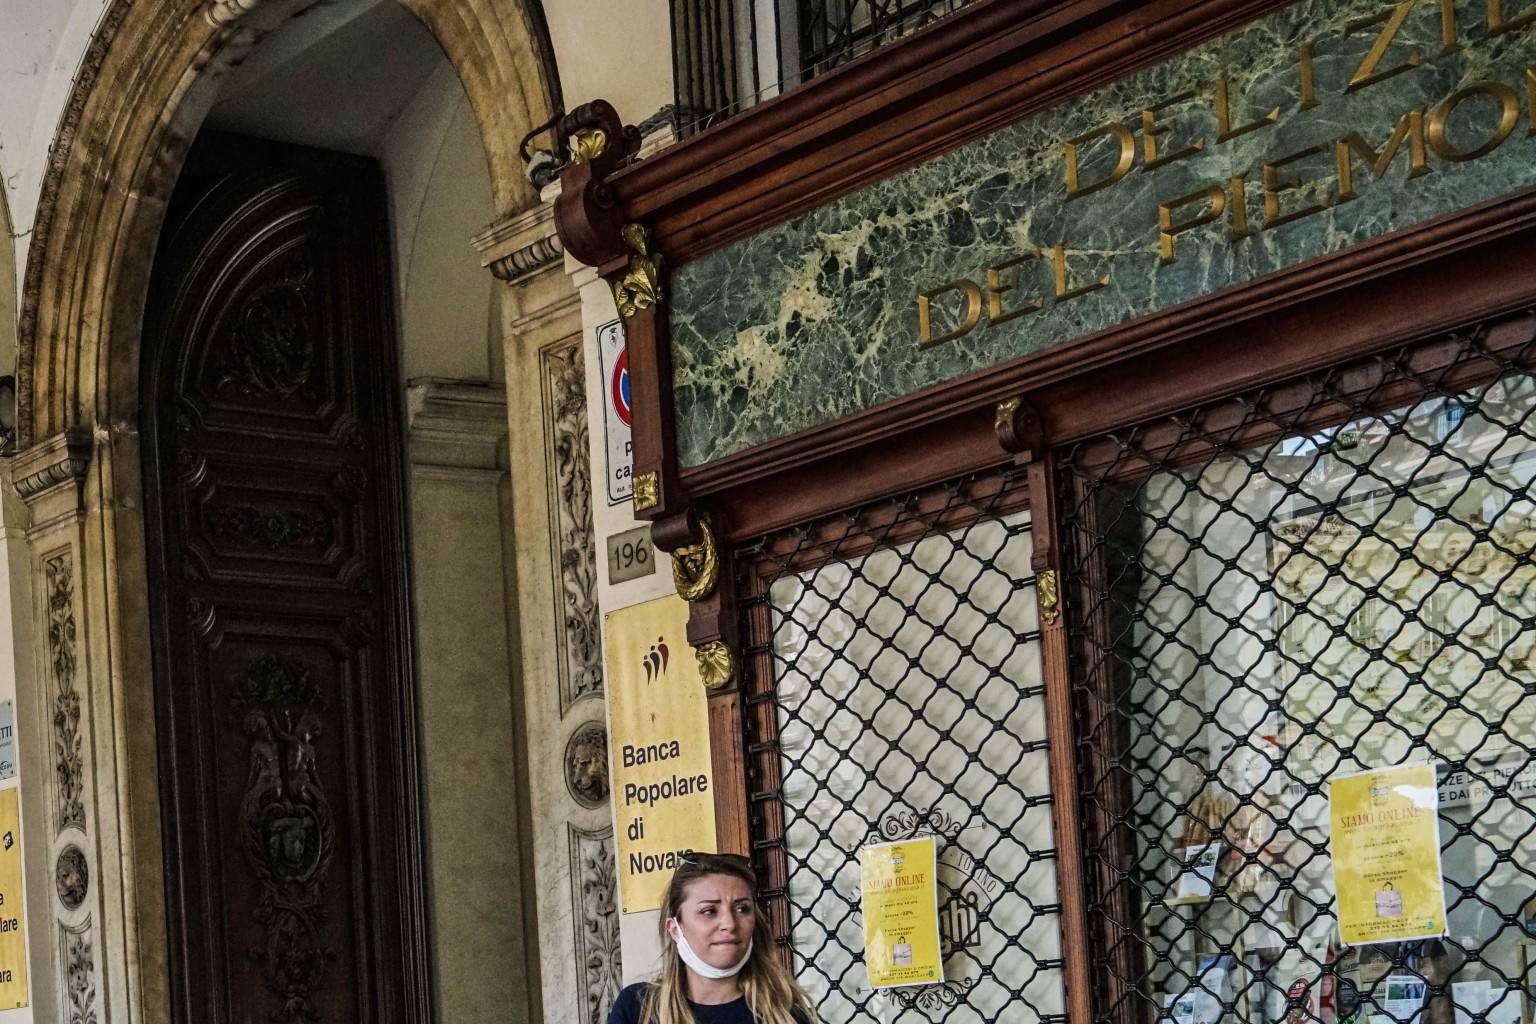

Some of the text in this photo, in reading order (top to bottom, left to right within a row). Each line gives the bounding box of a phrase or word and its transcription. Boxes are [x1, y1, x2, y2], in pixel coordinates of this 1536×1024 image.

[917, 242, 1111, 350] DEL
[614, 536, 648, 571] 196
[622, 739, 680, 768] Banca
[624, 773, 708, 807] Popolare
[627, 816, 644, 841] di
[1340, 813, 1373, 828] SIAMO
[895, 872, 926, 887] ONLINE
